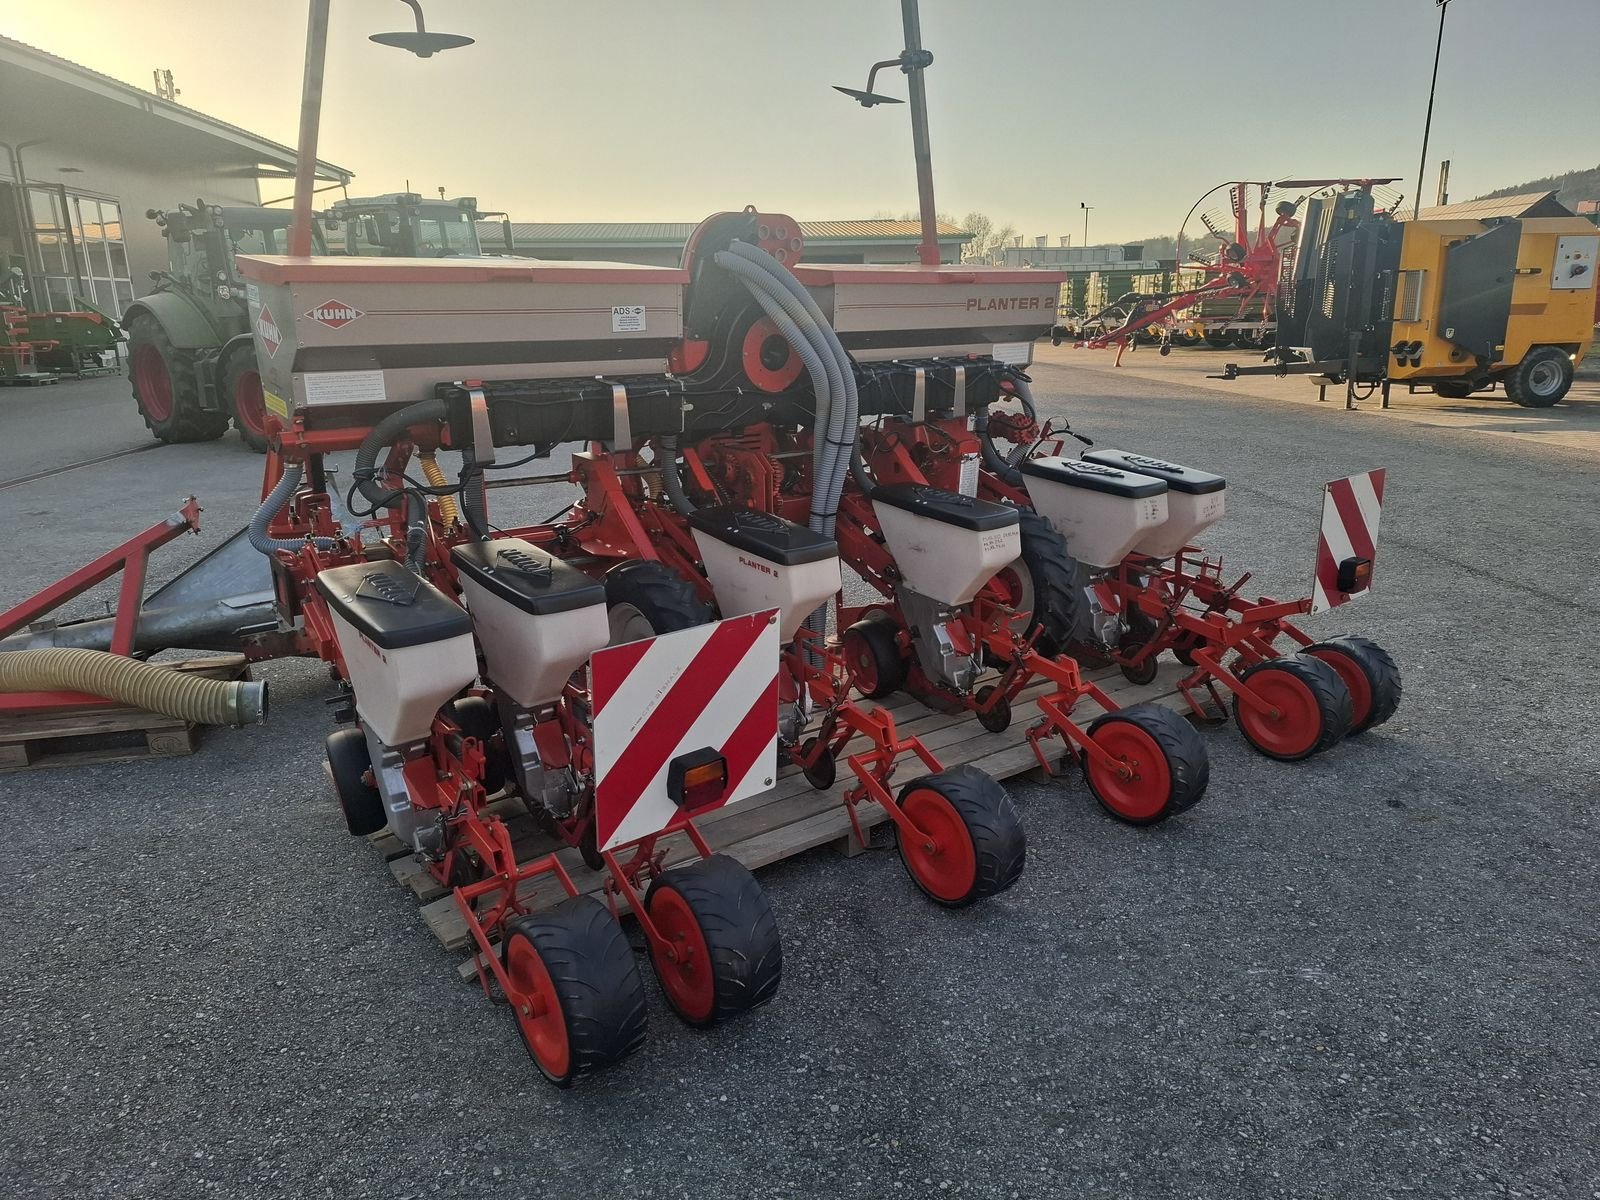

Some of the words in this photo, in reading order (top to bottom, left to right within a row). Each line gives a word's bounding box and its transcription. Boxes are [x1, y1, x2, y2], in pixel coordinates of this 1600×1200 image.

[613, 307, 631, 315] ADS
[966, 297, 1040, 312] PLANTER
[1044, 296, 1055, 309] 2
[313, 309, 357, 320] KUHN
[260, 319, 280, 345] KUHN
[738, 556, 771, 575] PLANTER
[773, 570, 779, 578] 2
